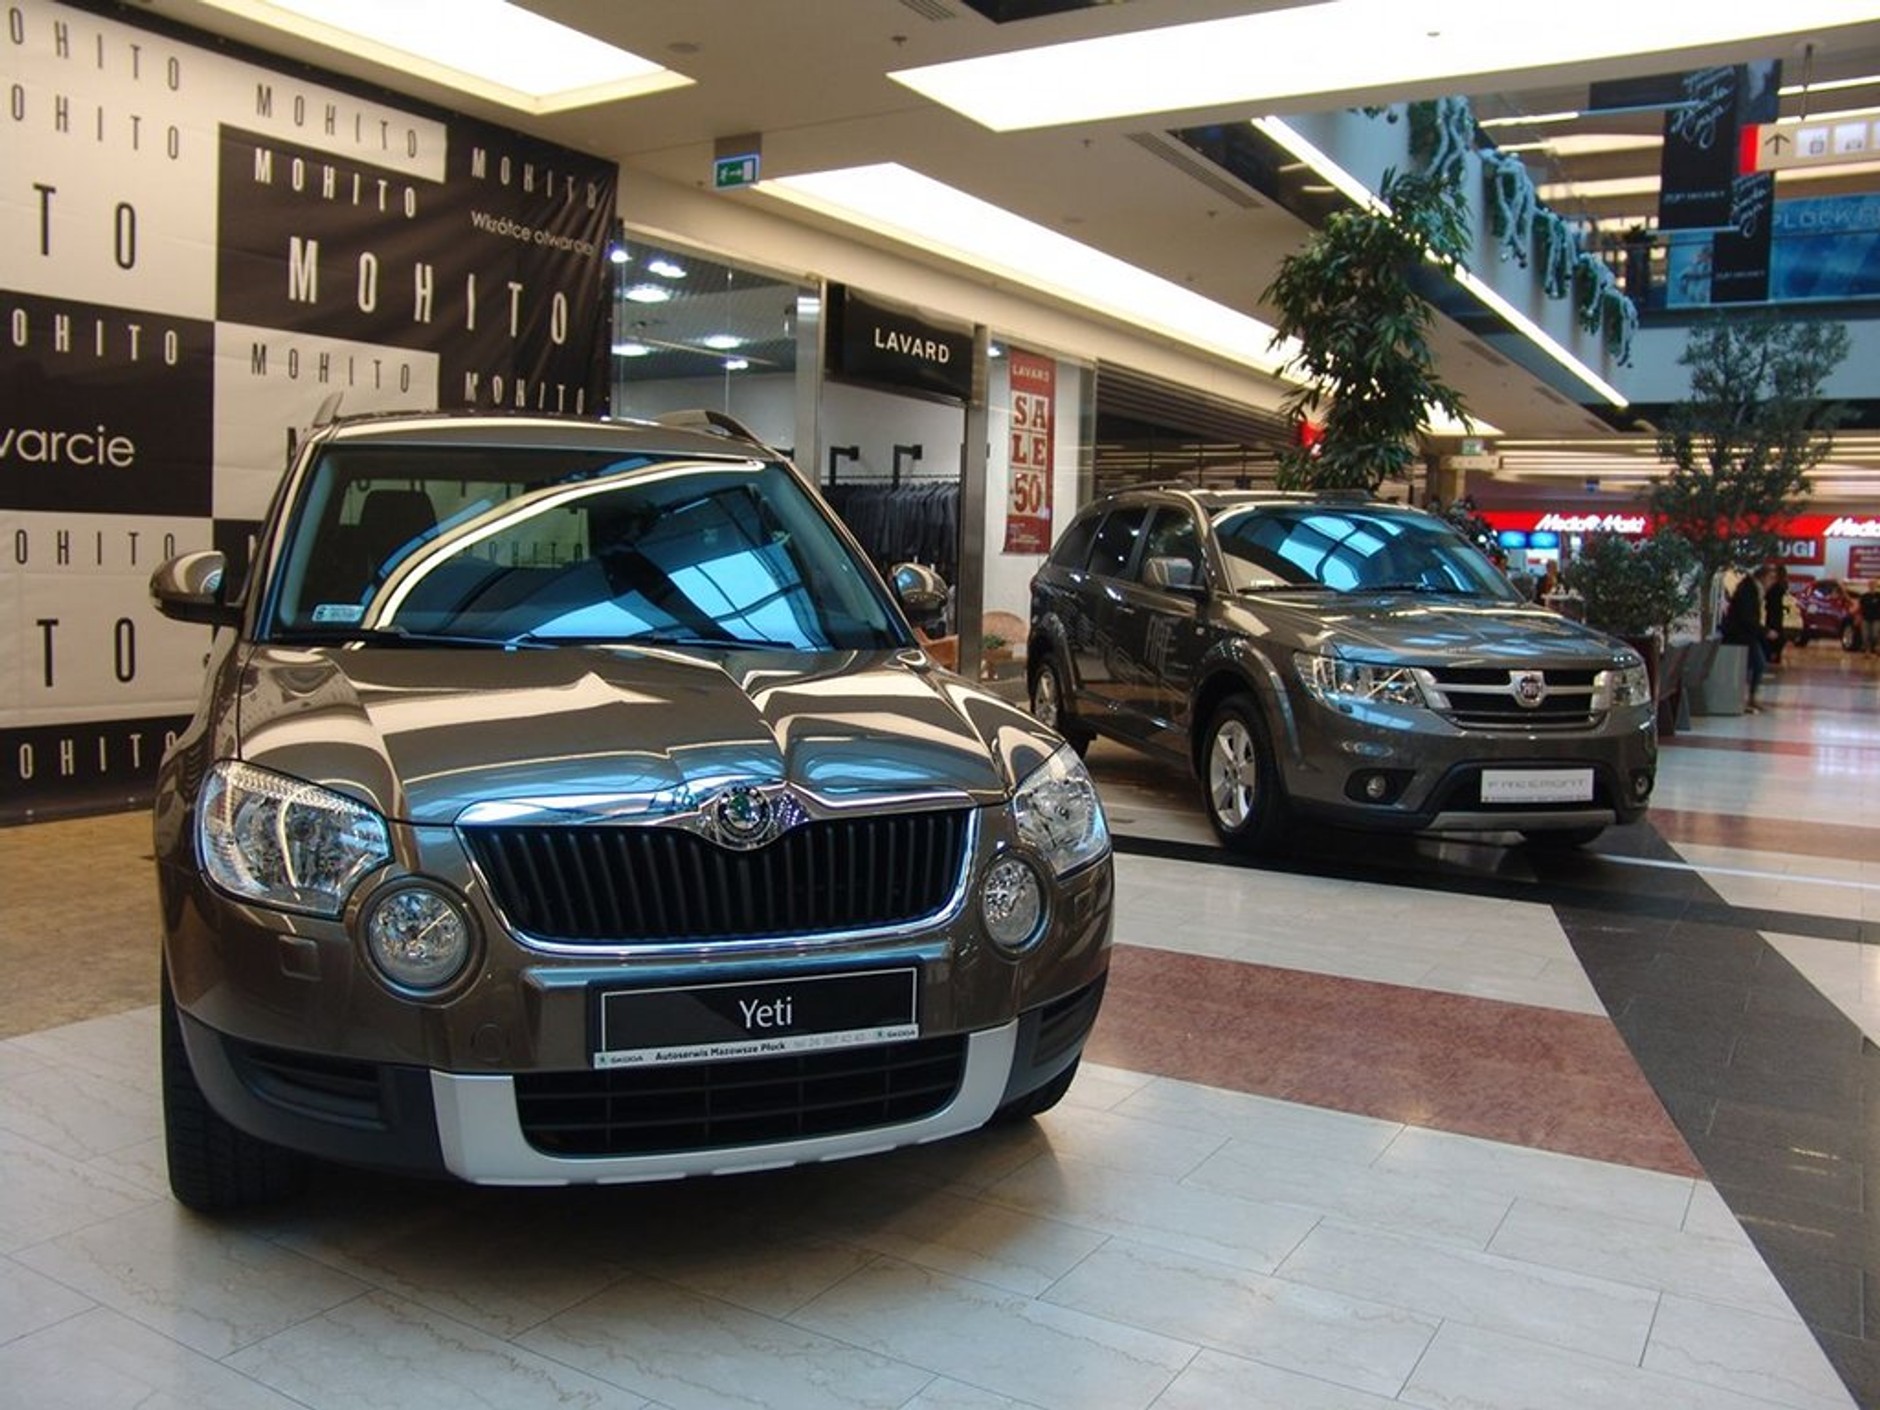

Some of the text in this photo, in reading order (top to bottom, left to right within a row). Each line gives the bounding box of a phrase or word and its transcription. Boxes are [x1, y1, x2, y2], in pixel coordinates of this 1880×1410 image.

[256, 84, 417, 158] MOHITO
[255, 148, 416, 218] MOHITO
[472, 147, 597, 210] MOHITO
[289, 236, 567, 345] MOHITO
[251, 343, 410, 394] MOHITO
[875, 327, 950, 364] LAVARD
[465, 371, 584, 414] MOHITO
[739, 996, 792, 1028] Yeti
